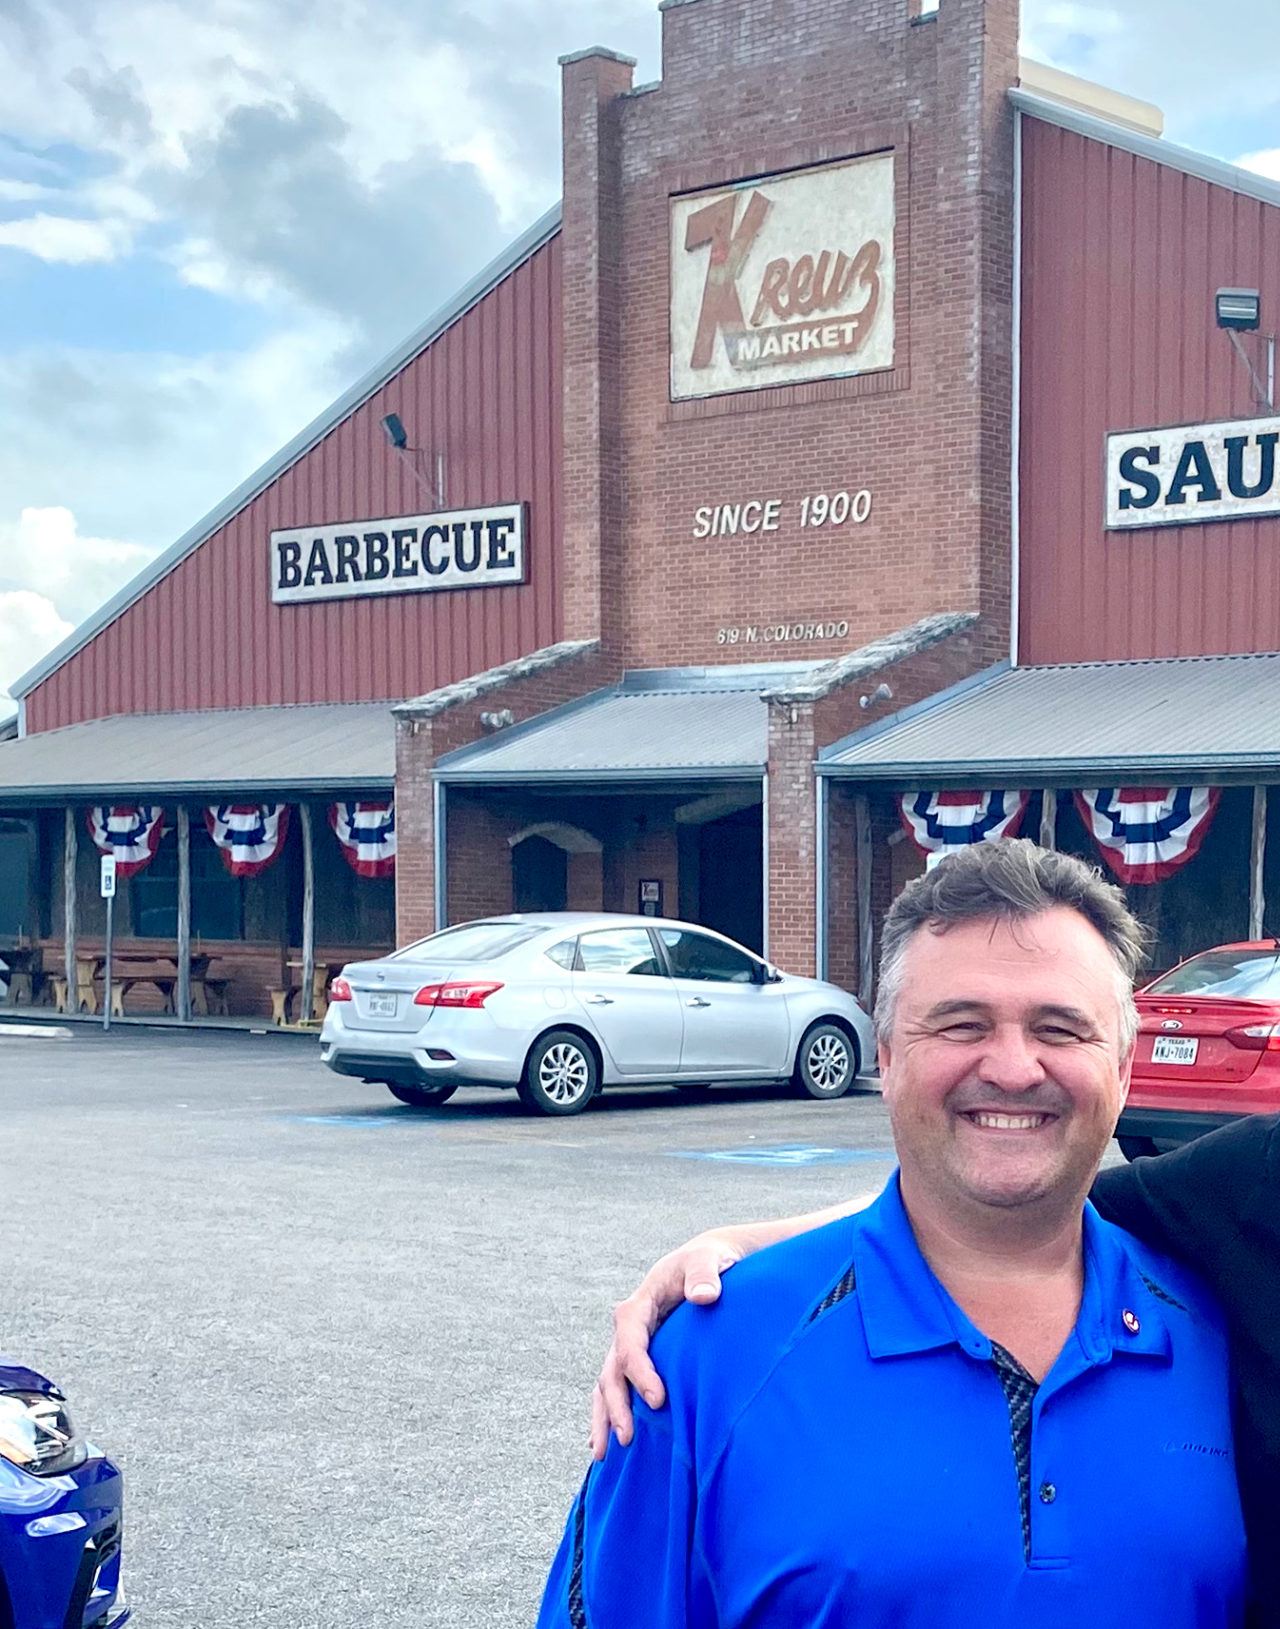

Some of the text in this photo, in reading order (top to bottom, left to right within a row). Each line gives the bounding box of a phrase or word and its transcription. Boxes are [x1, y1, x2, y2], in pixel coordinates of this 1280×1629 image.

[738, 322, 859, 361] MARKET
[693, 489, 872, 538] SINCE 1900
[278, 518, 515, 589] BARBECUE
[717, 628, 740, 645] 619
[763, 621, 849, 642] COLORADO
